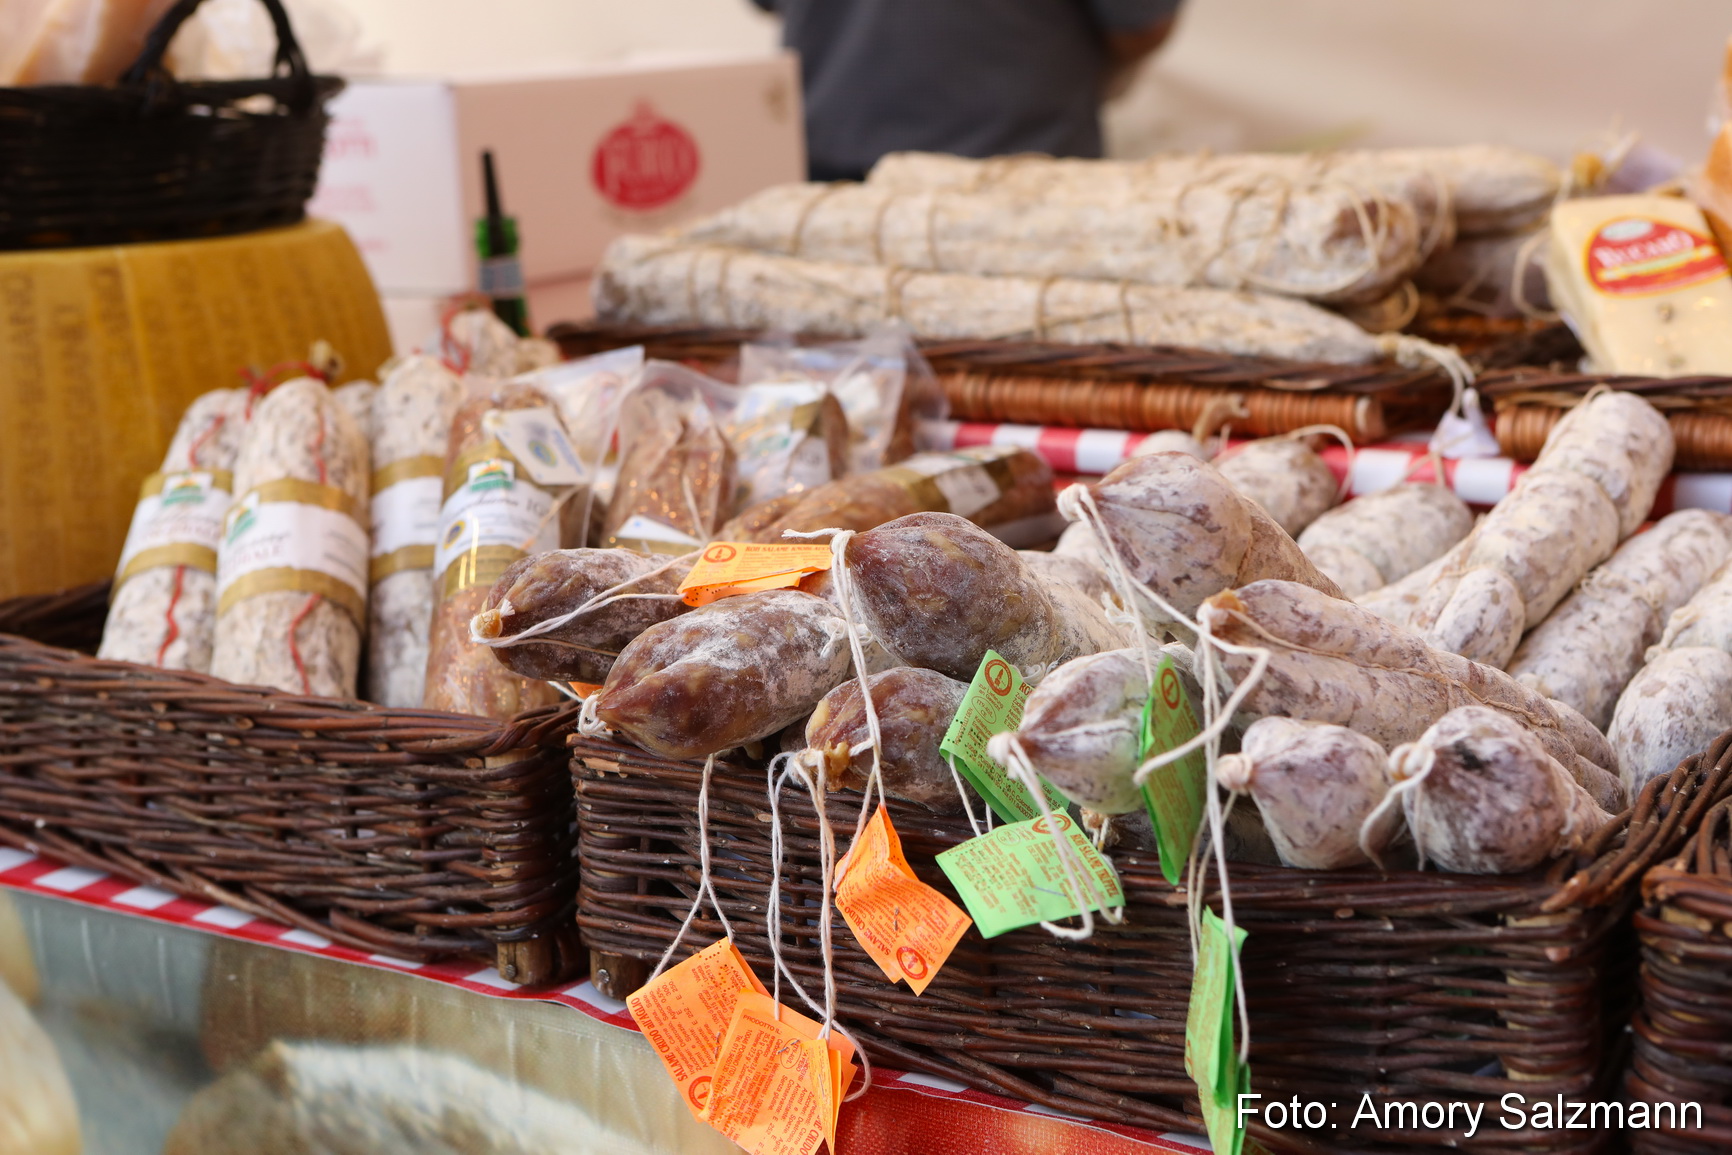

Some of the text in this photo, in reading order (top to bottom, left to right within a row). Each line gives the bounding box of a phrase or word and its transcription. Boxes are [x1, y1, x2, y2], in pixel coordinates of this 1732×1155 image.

[843, 905, 866, 930] CRUDO
[862, 928, 891, 956] SALAME
[665, 1004, 678, 1020] Aglio
[683, 1006, 694, 1018] 252
[742, 1014, 775, 1031] PRODOTTO
[629, 996, 688, 1082] SALAME CRUDO all'AGLIO
[661, 1027, 675, 1045] Carne
[687, 1026, 715, 1065] Antiossidante:
[673, 1044, 696, 1074] Ingredienti:
[683, 1047, 702, 1072] Zuccheri:
[694, 1051, 708, 1068] Aromi
[795, 1056, 805, 1072] PESO
[766, 1074, 787, 1112] Senza glutine.
[774, 1078, 794, 1114] Conservante:
[779, 1082, 801, 1121] Antiossidante:
[796, 1086, 808, 1104] Aromi
[800, 1090, 815, 1115] Zuccheri:
[793, 1099, 818, 1145] gredienti: Carne
[797, 1128, 820, 1155] CRUDO
